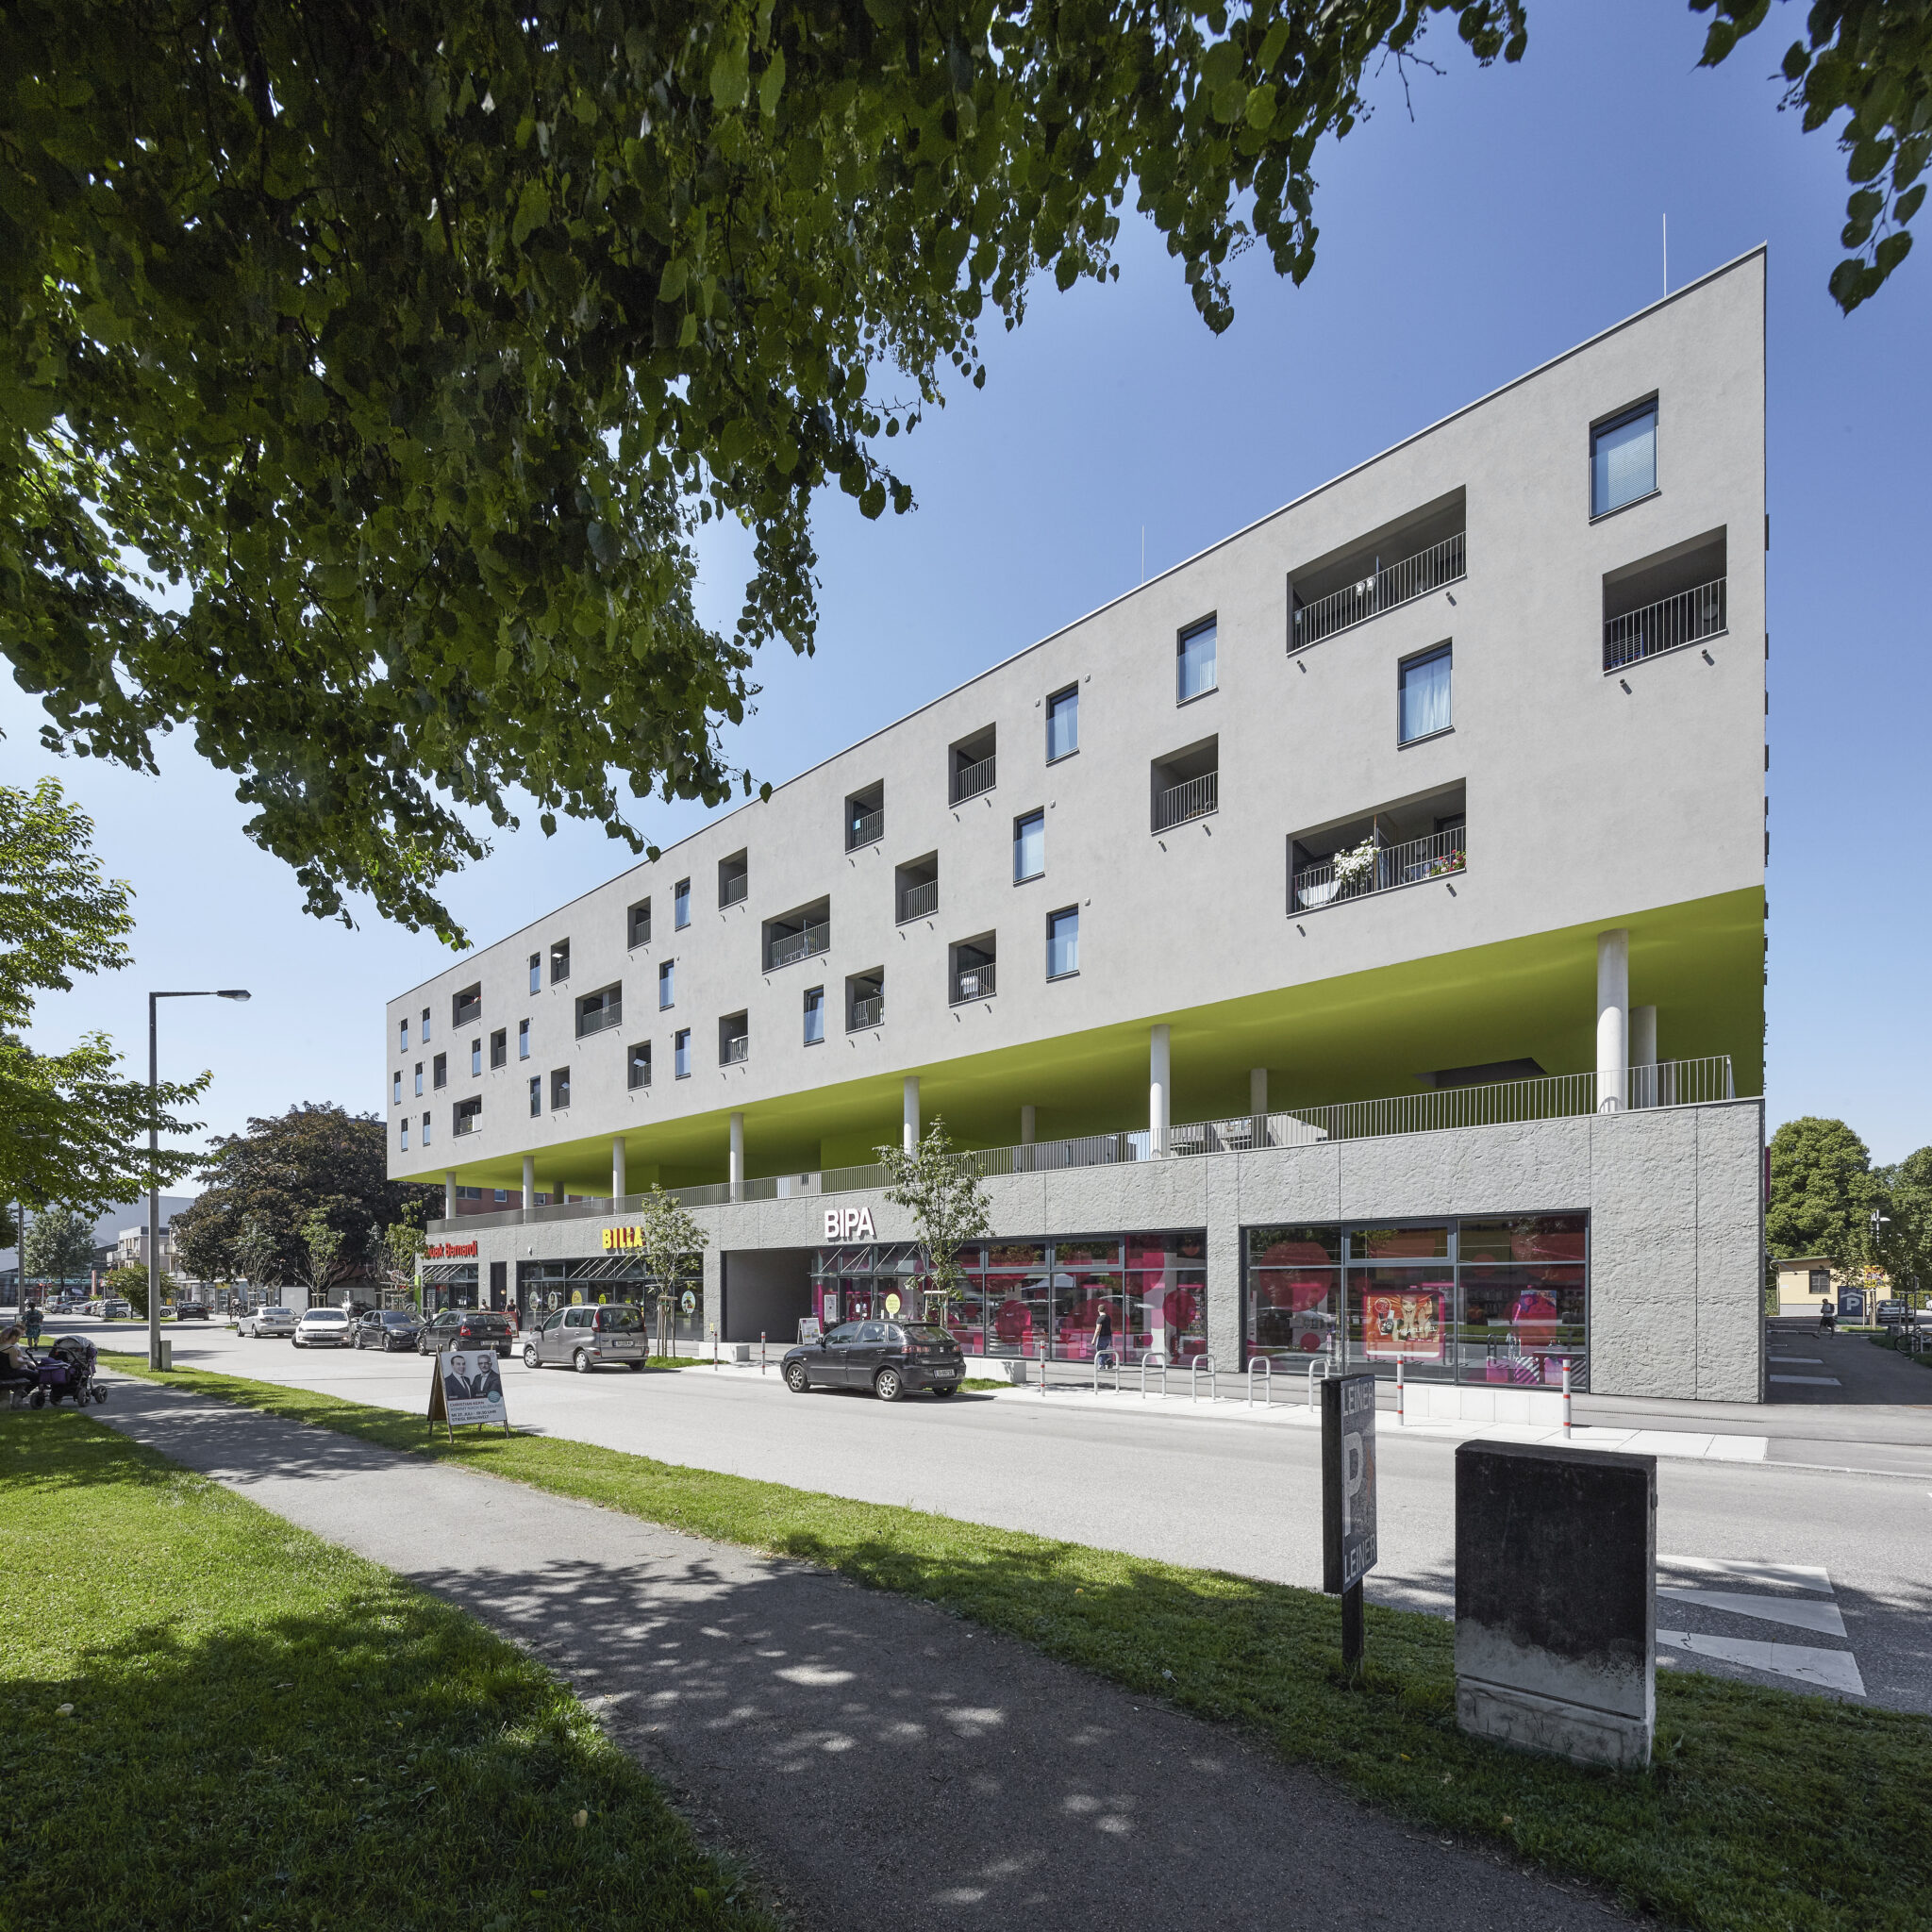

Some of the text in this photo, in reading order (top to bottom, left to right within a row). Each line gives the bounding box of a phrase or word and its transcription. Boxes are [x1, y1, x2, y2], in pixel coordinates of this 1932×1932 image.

[602, 1225, 646, 1250] BILLA
[824, 1207, 875, 1239] BIPA
[445, 1240, 477, 1257] Bernardi
[1342, 1381, 1374, 1416] LEINER
[1343, 1430, 1364, 1538] P
[1343, 1534, 1375, 1585] LEINER
